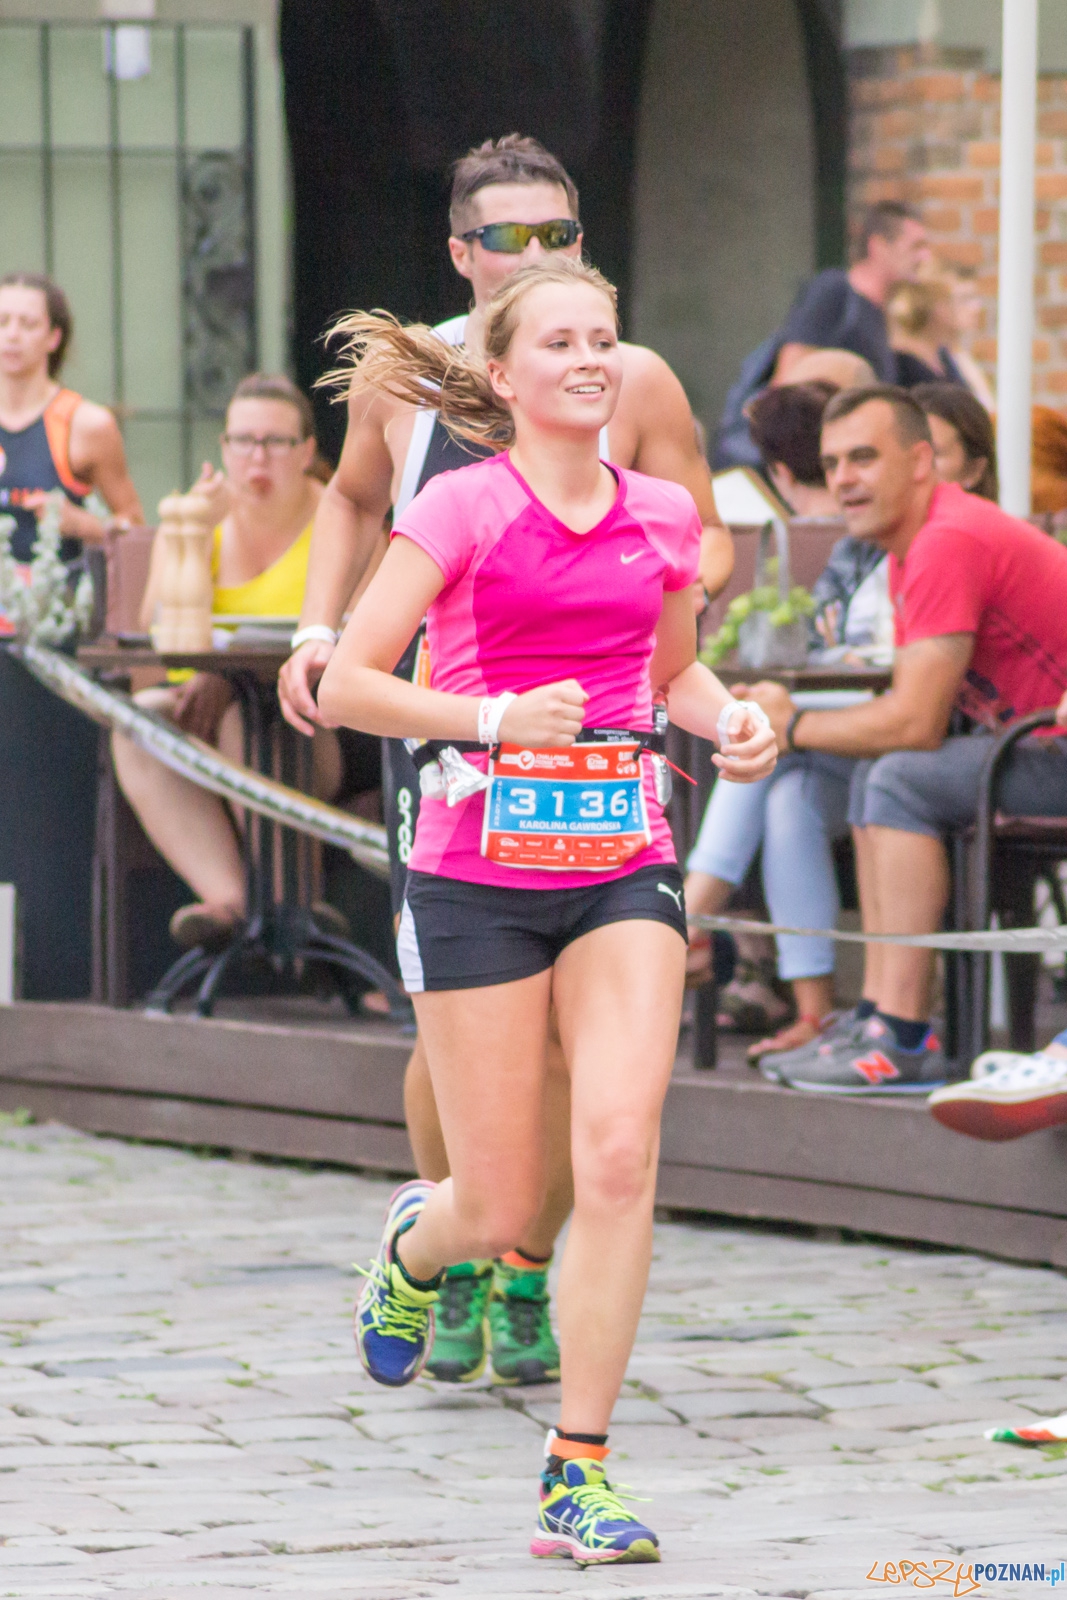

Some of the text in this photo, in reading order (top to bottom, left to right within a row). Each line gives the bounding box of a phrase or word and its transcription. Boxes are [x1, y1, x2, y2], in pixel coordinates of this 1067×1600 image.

[508, 787, 629, 818] 3136
[398, 787, 412, 864] orca
[519, 820, 567, 831] KAROLINA
